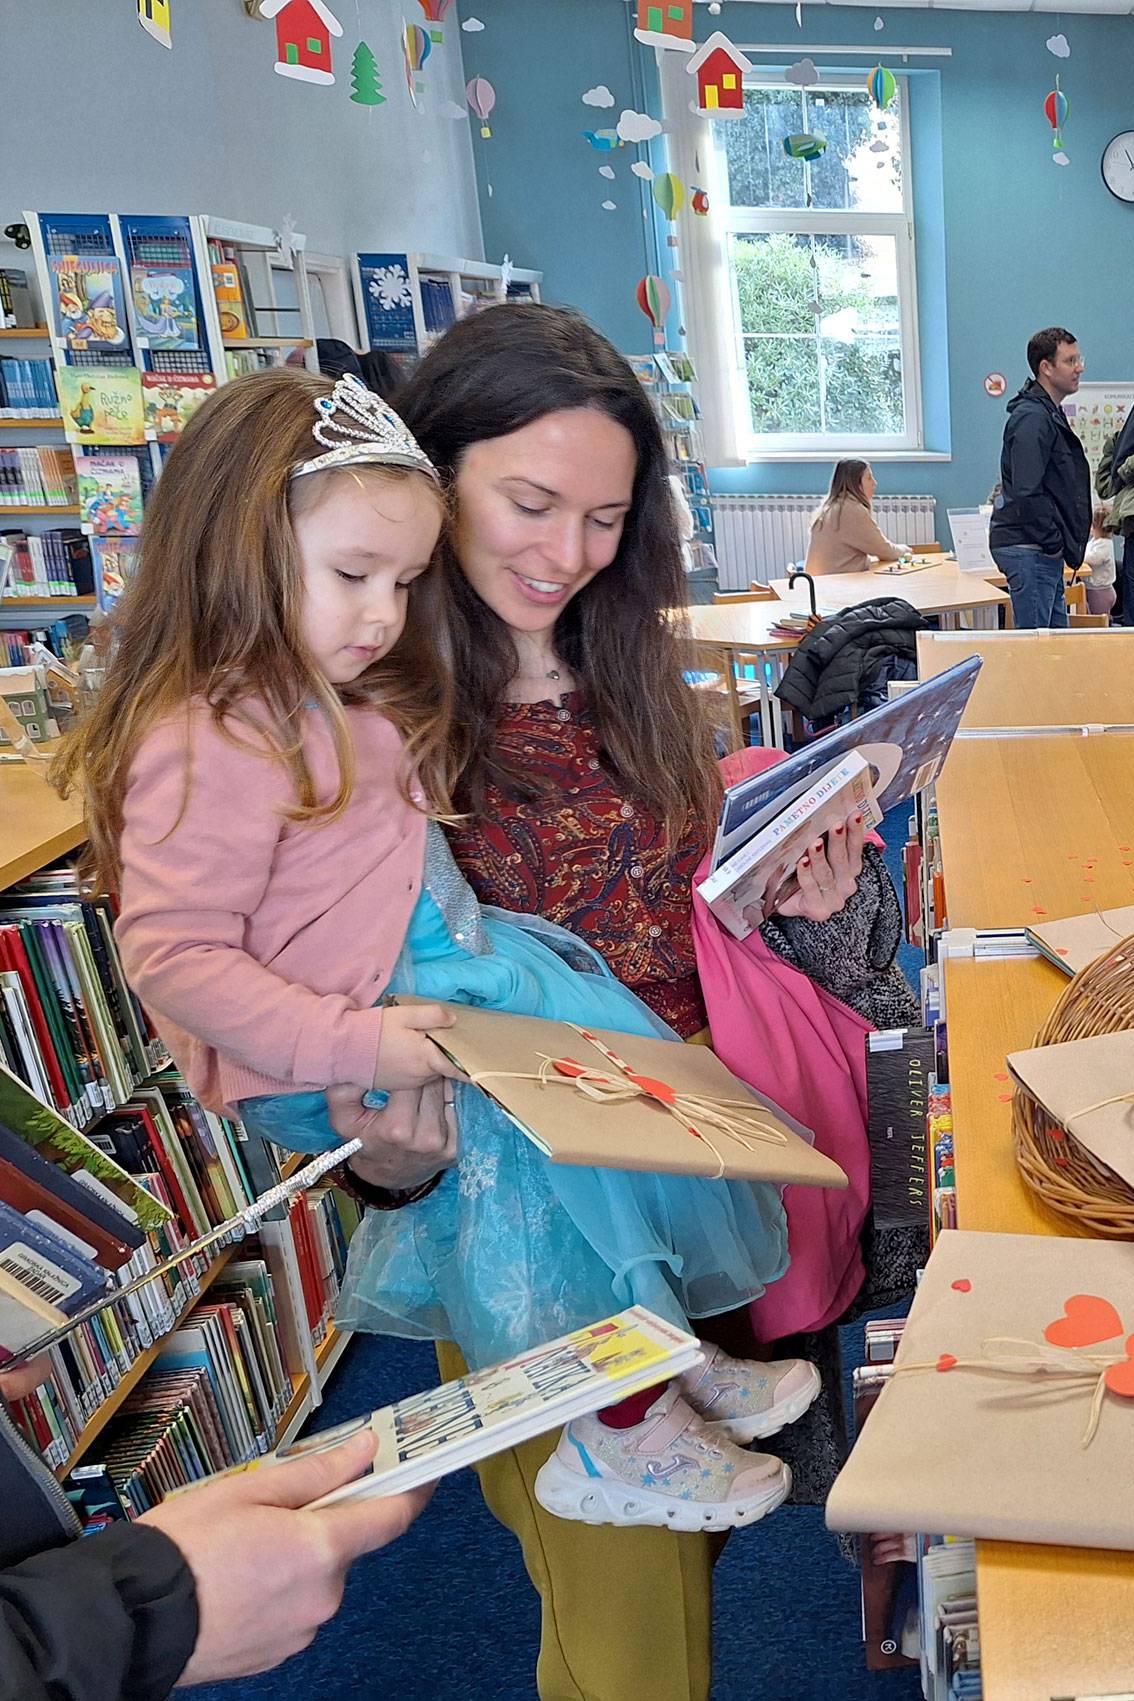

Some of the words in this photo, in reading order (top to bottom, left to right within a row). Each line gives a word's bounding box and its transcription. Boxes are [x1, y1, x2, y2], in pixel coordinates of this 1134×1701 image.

[101, 391, 132, 406] Ružno
[105, 406, 129, 422] pače
[772, 796, 817, 836] PAMETNO
[816, 767, 851, 798] DIJETE
[908, 1058, 924, 1118] OLIVER
[908, 1135, 925, 1207] JEFFERS
